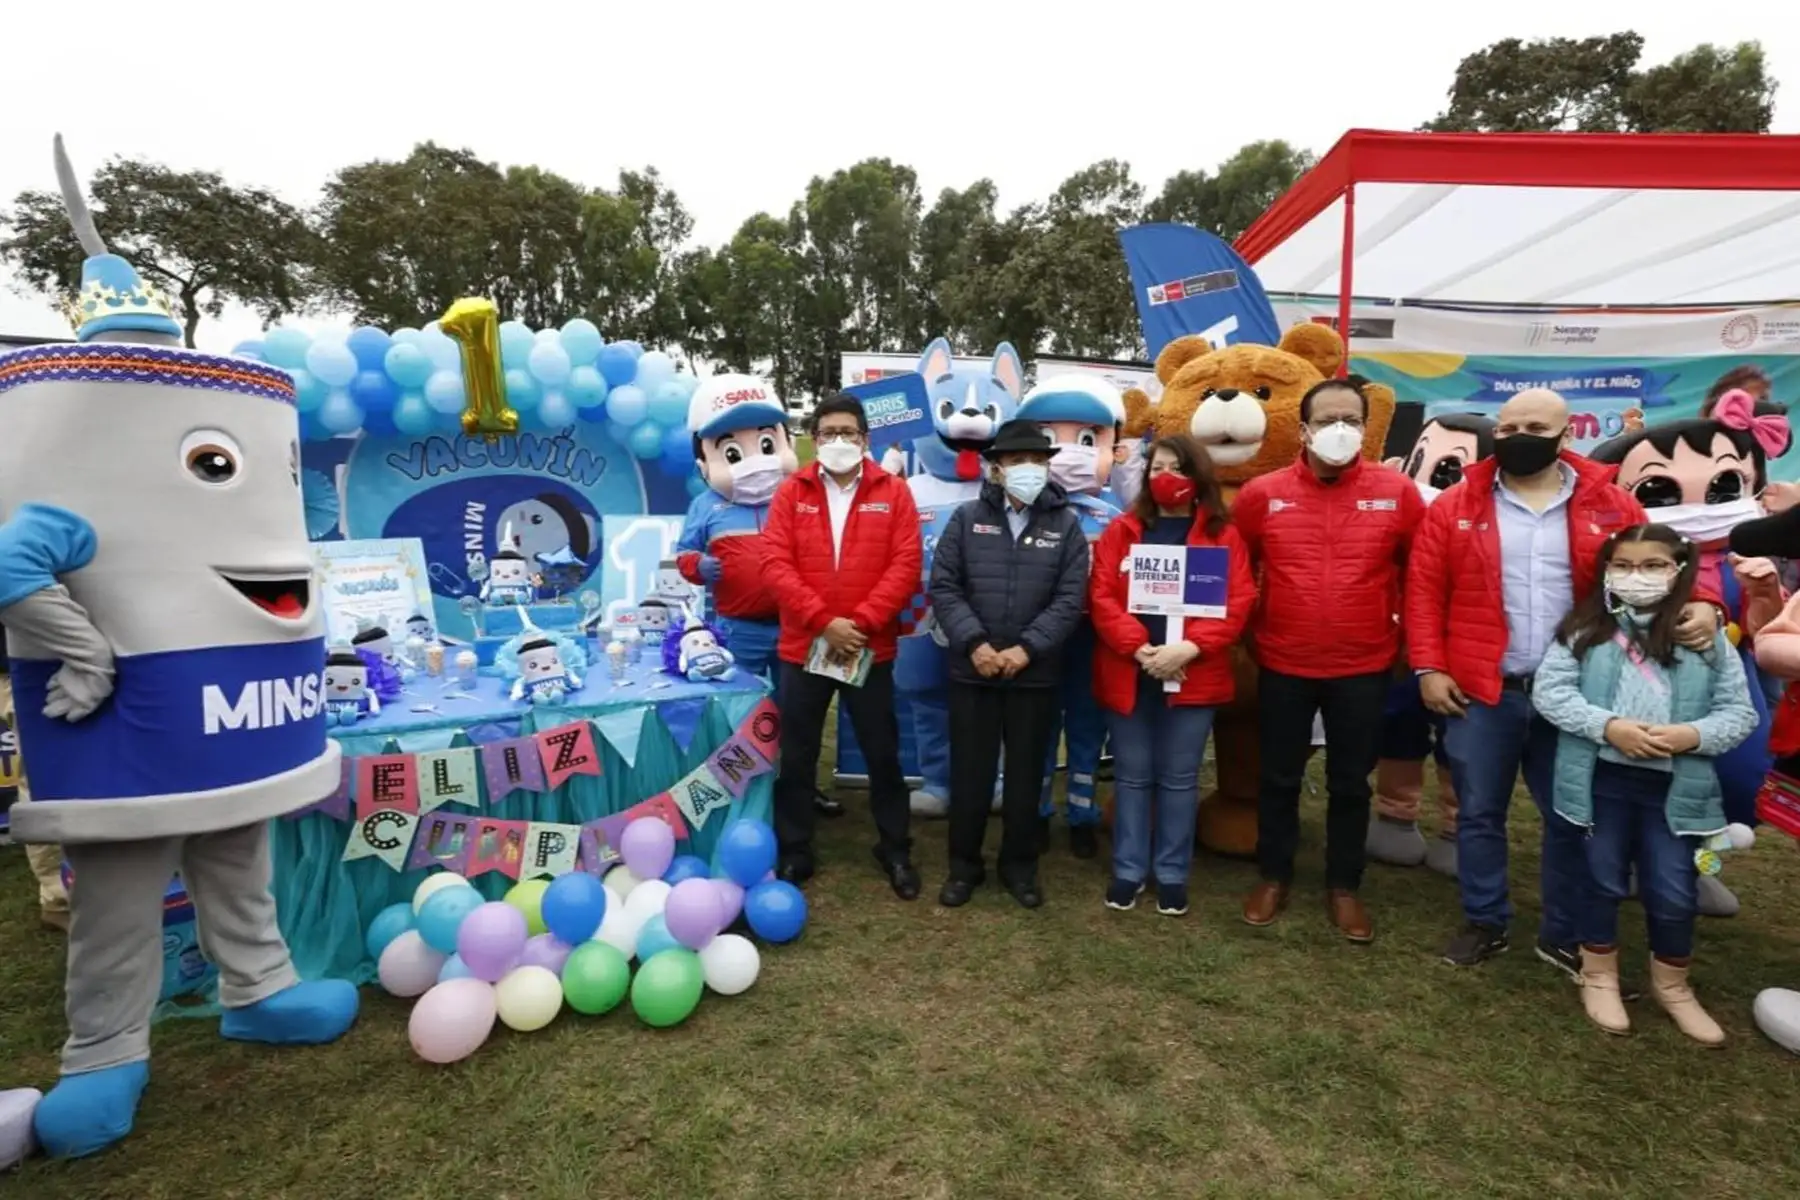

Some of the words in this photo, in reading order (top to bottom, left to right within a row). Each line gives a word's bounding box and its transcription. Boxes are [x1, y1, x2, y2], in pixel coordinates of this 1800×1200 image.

[1493, 377, 1514, 392] DÍA
[1550, 376, 1581, 390] NIÑA
[1583, 378, 1592, 388] Y
[1592, 377, 1607, 389] EL
[1608, 374, 1642, 389] NIÑO
[725, 388, 767, 405] SAMU
[867, 393, 905, 416] DIRIS
[867, 418, 885, 428] ma
[884, 407, 923, 425] Centro
[386, 424, 607, 487] VACUNÍN
[464, 501, 487, 567] MINS
[1134, 557, 1161, 571] HAZ
[1164, 558, 1180, 572] LA
[1134, 571, 1180, 581] DIFERENCIA
[371, 728, 589, 803] ELIZ
